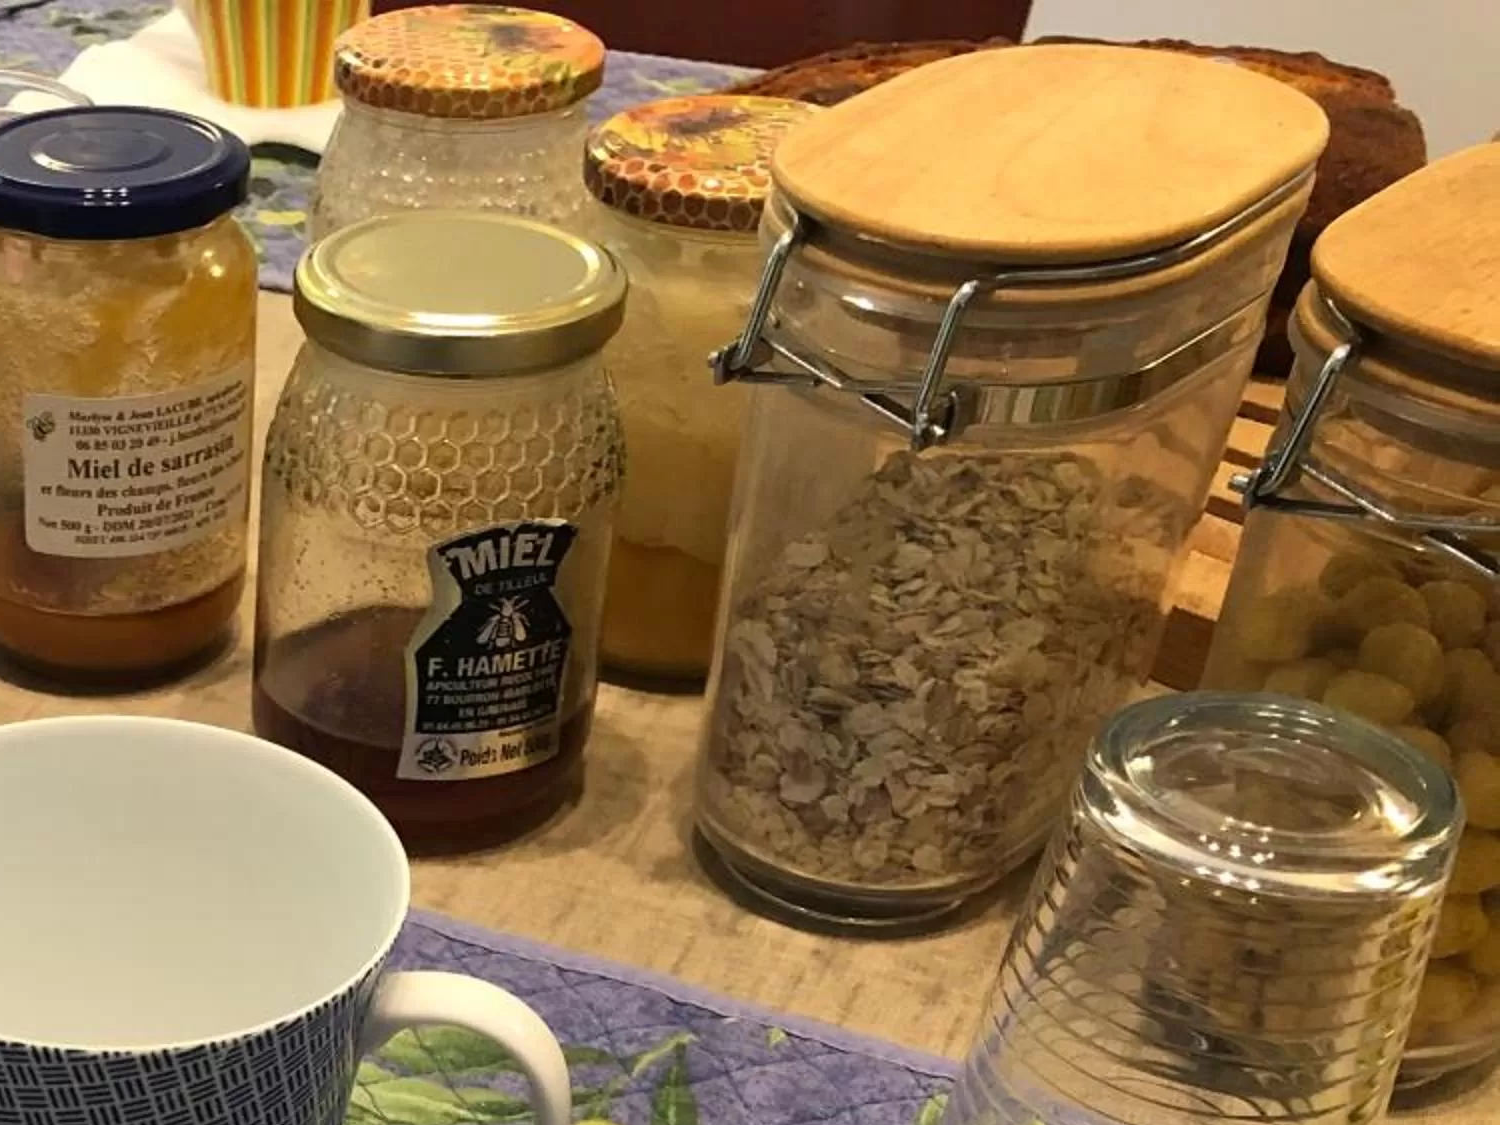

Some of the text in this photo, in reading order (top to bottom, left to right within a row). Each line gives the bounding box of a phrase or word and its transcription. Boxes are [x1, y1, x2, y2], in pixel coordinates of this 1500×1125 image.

[68, 457, 120, 480] Miel
[127, 457, 156, 477] de
[161, 434, 234, 473] sarrasin
[97, 501, 152, 517] Produit
[447, 532, 556, 579] MIEL
[427, 656, 449, 678] F.
[457, 641, 561, 678] HAMETTE
